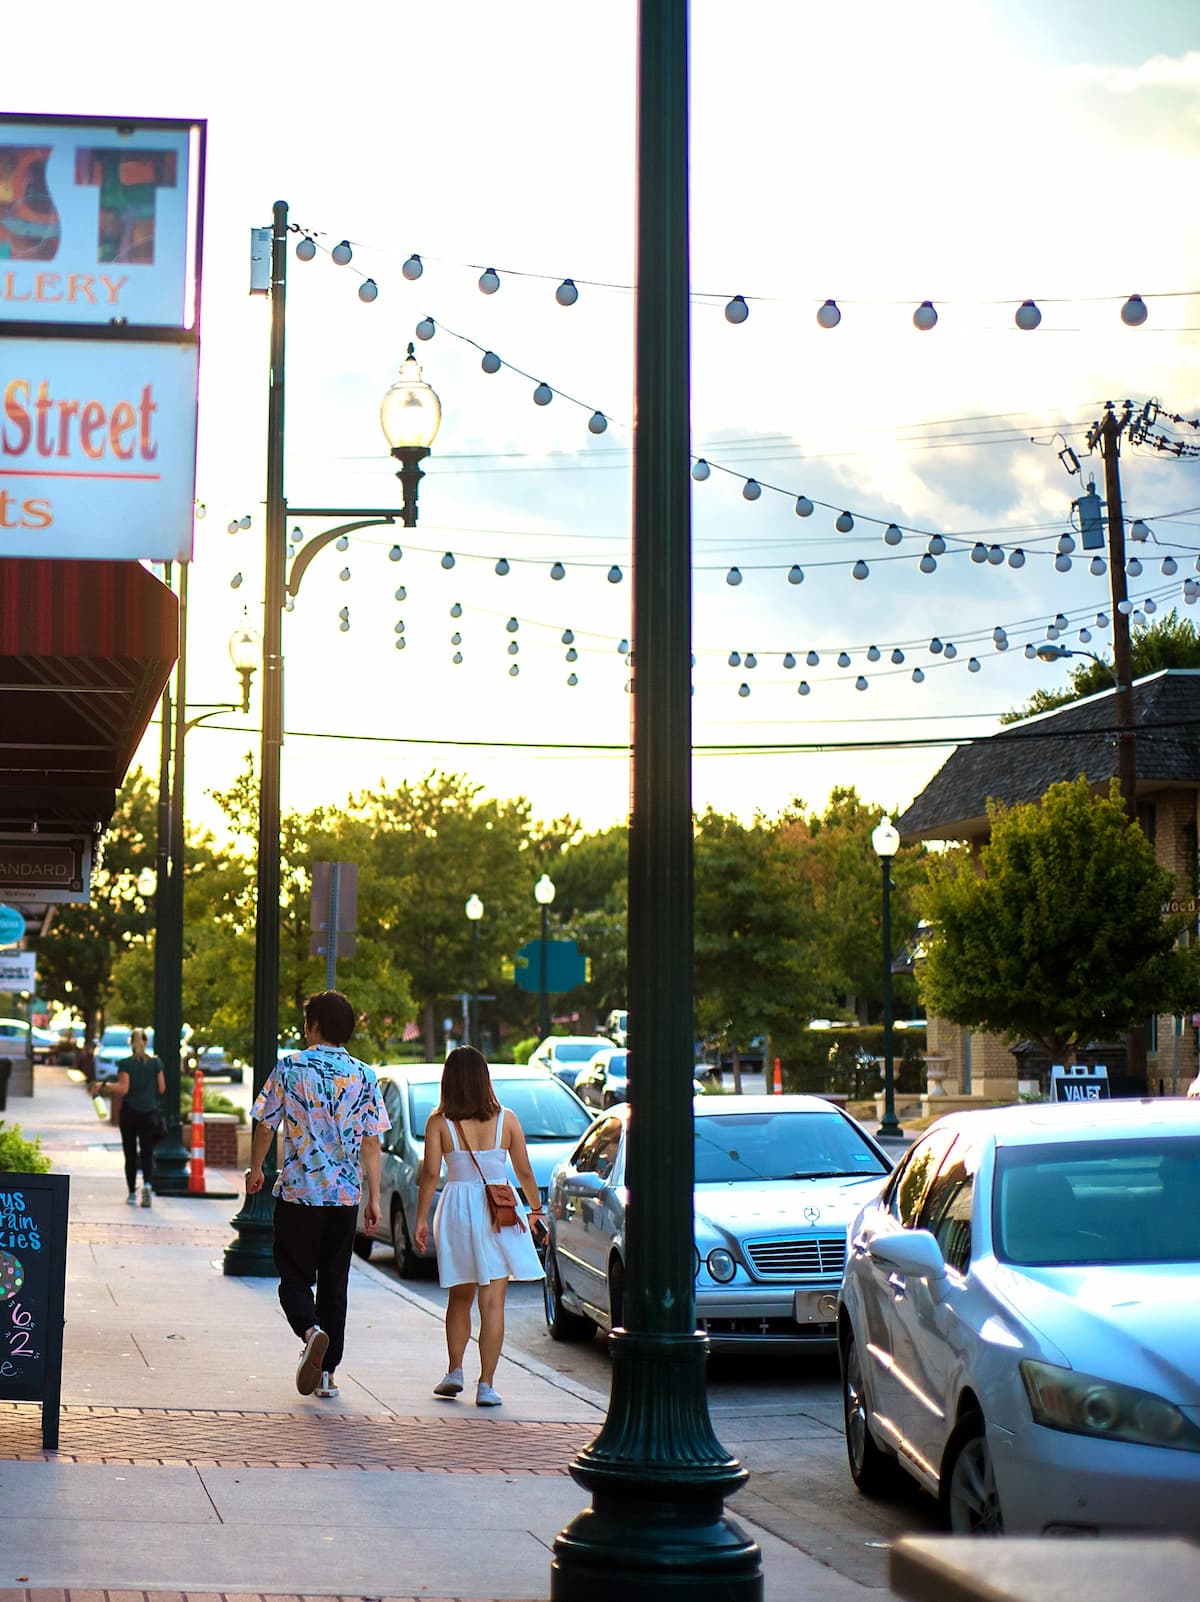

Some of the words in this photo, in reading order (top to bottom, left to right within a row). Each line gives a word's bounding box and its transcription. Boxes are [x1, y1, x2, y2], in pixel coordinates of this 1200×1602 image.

[2, 378, 159, 461] Street
[1064, 1085, 1101, 1101] VALET
[11, 1303, 32, 1327] 6
[9, 1331, 34, 1354] 2
